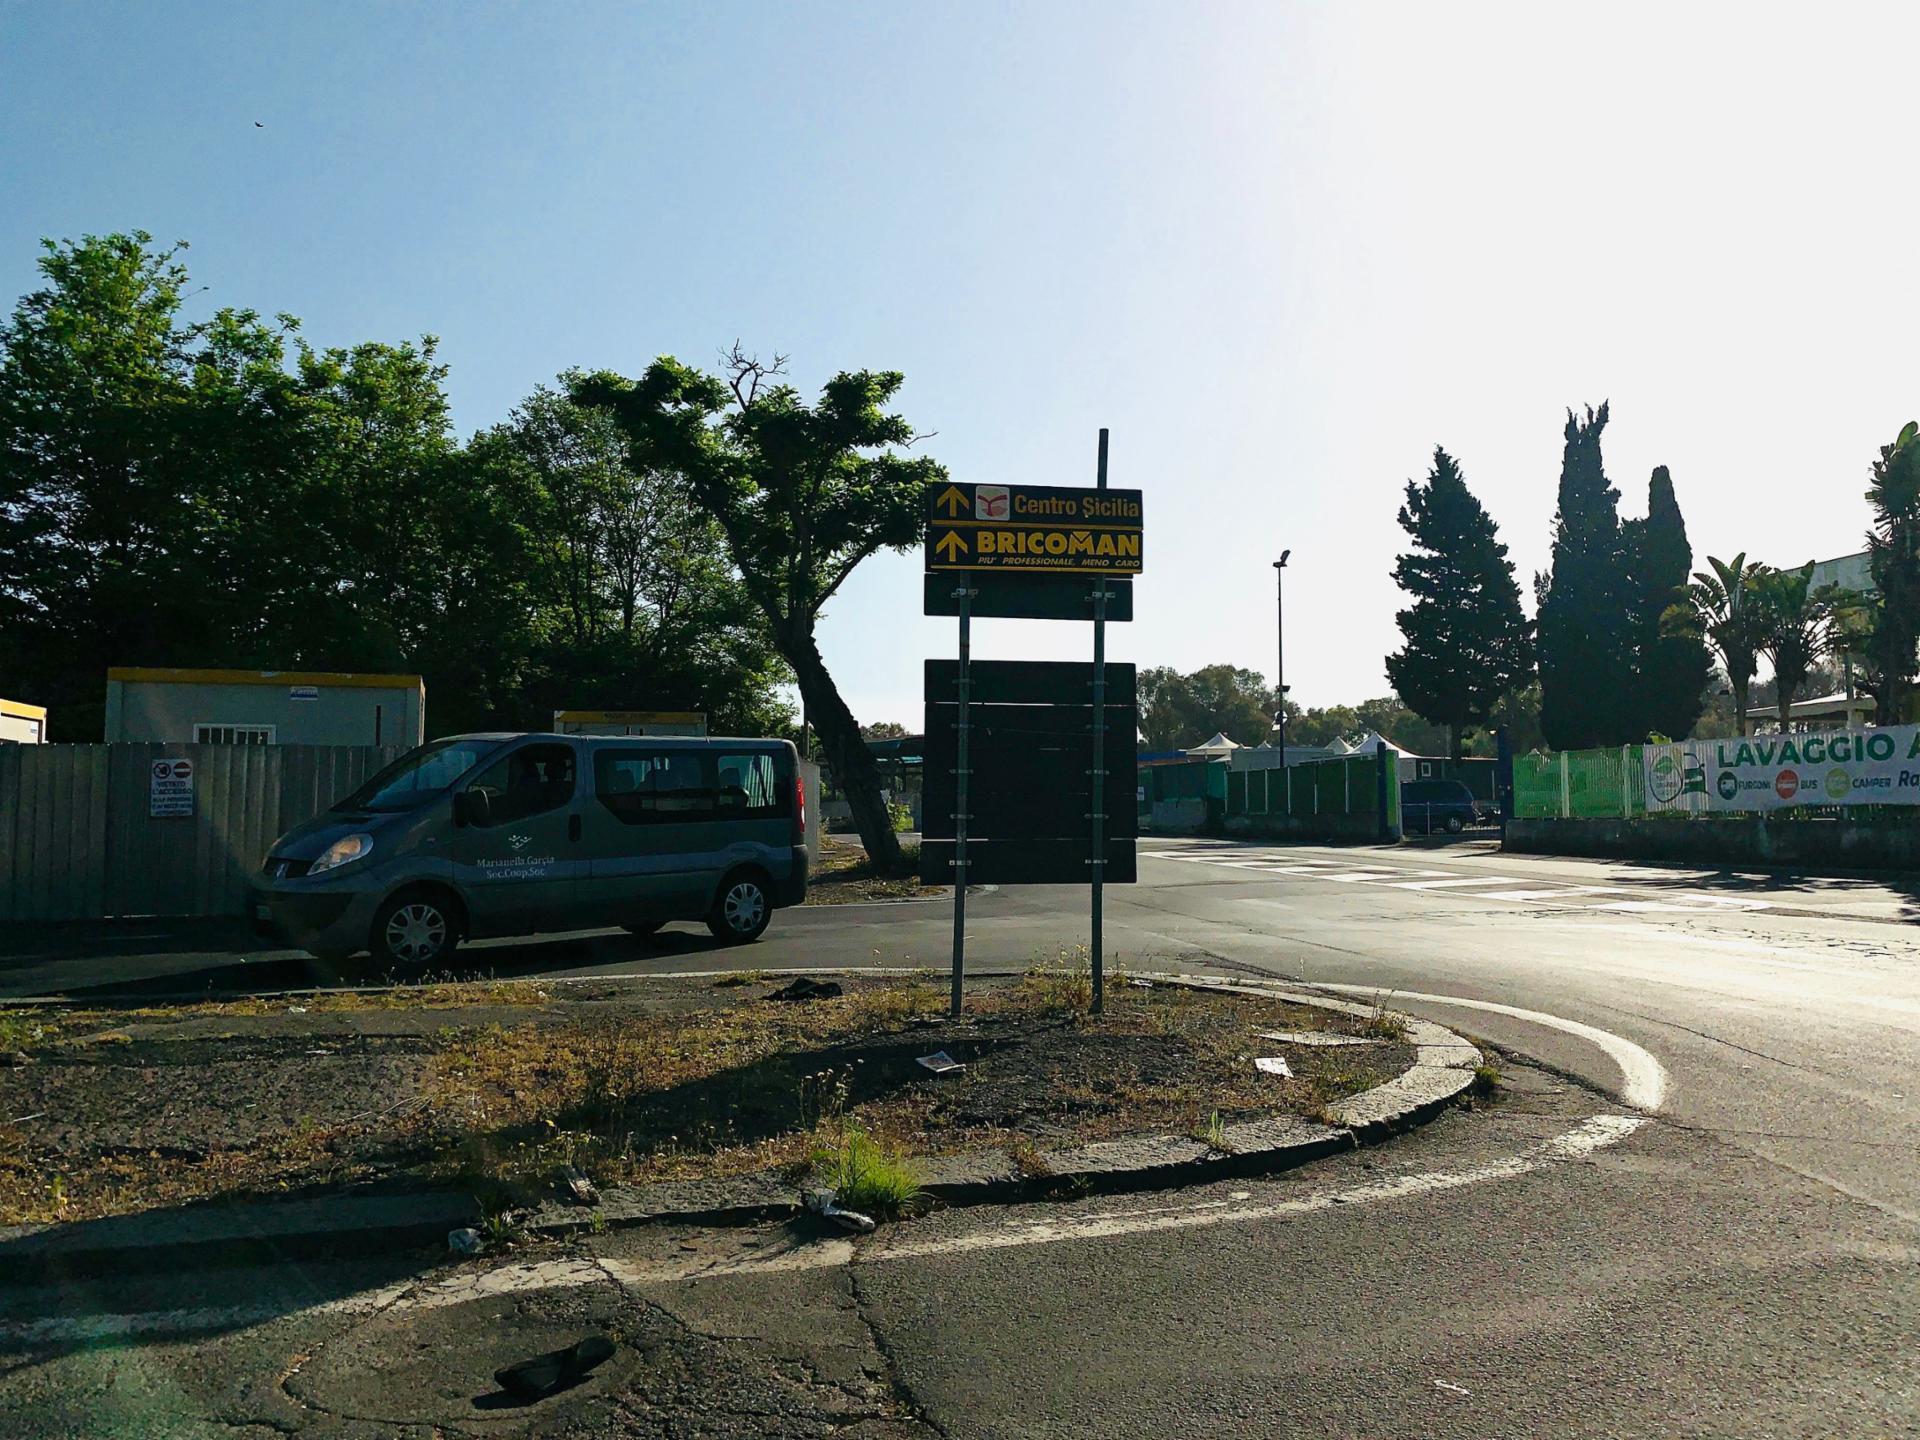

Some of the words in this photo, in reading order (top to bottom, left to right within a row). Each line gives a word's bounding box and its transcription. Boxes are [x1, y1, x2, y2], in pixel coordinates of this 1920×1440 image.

[1014, 494, 1077, 516] Centro
[1082, 495, 1139, 518] Sicilia
[977, 531, 1139, 556] BRICOMAN
[1081, 558, 1110, 567] MENO
[1114, 559, 1140, 567] CARO
[1717, 733, 1895, 769] LAVAGGIO
[1800, 779, 1818, 790] BUS
[1852, 777, 1892, 789] CAMPER
[1898, 769, 1920, 788] Ra
